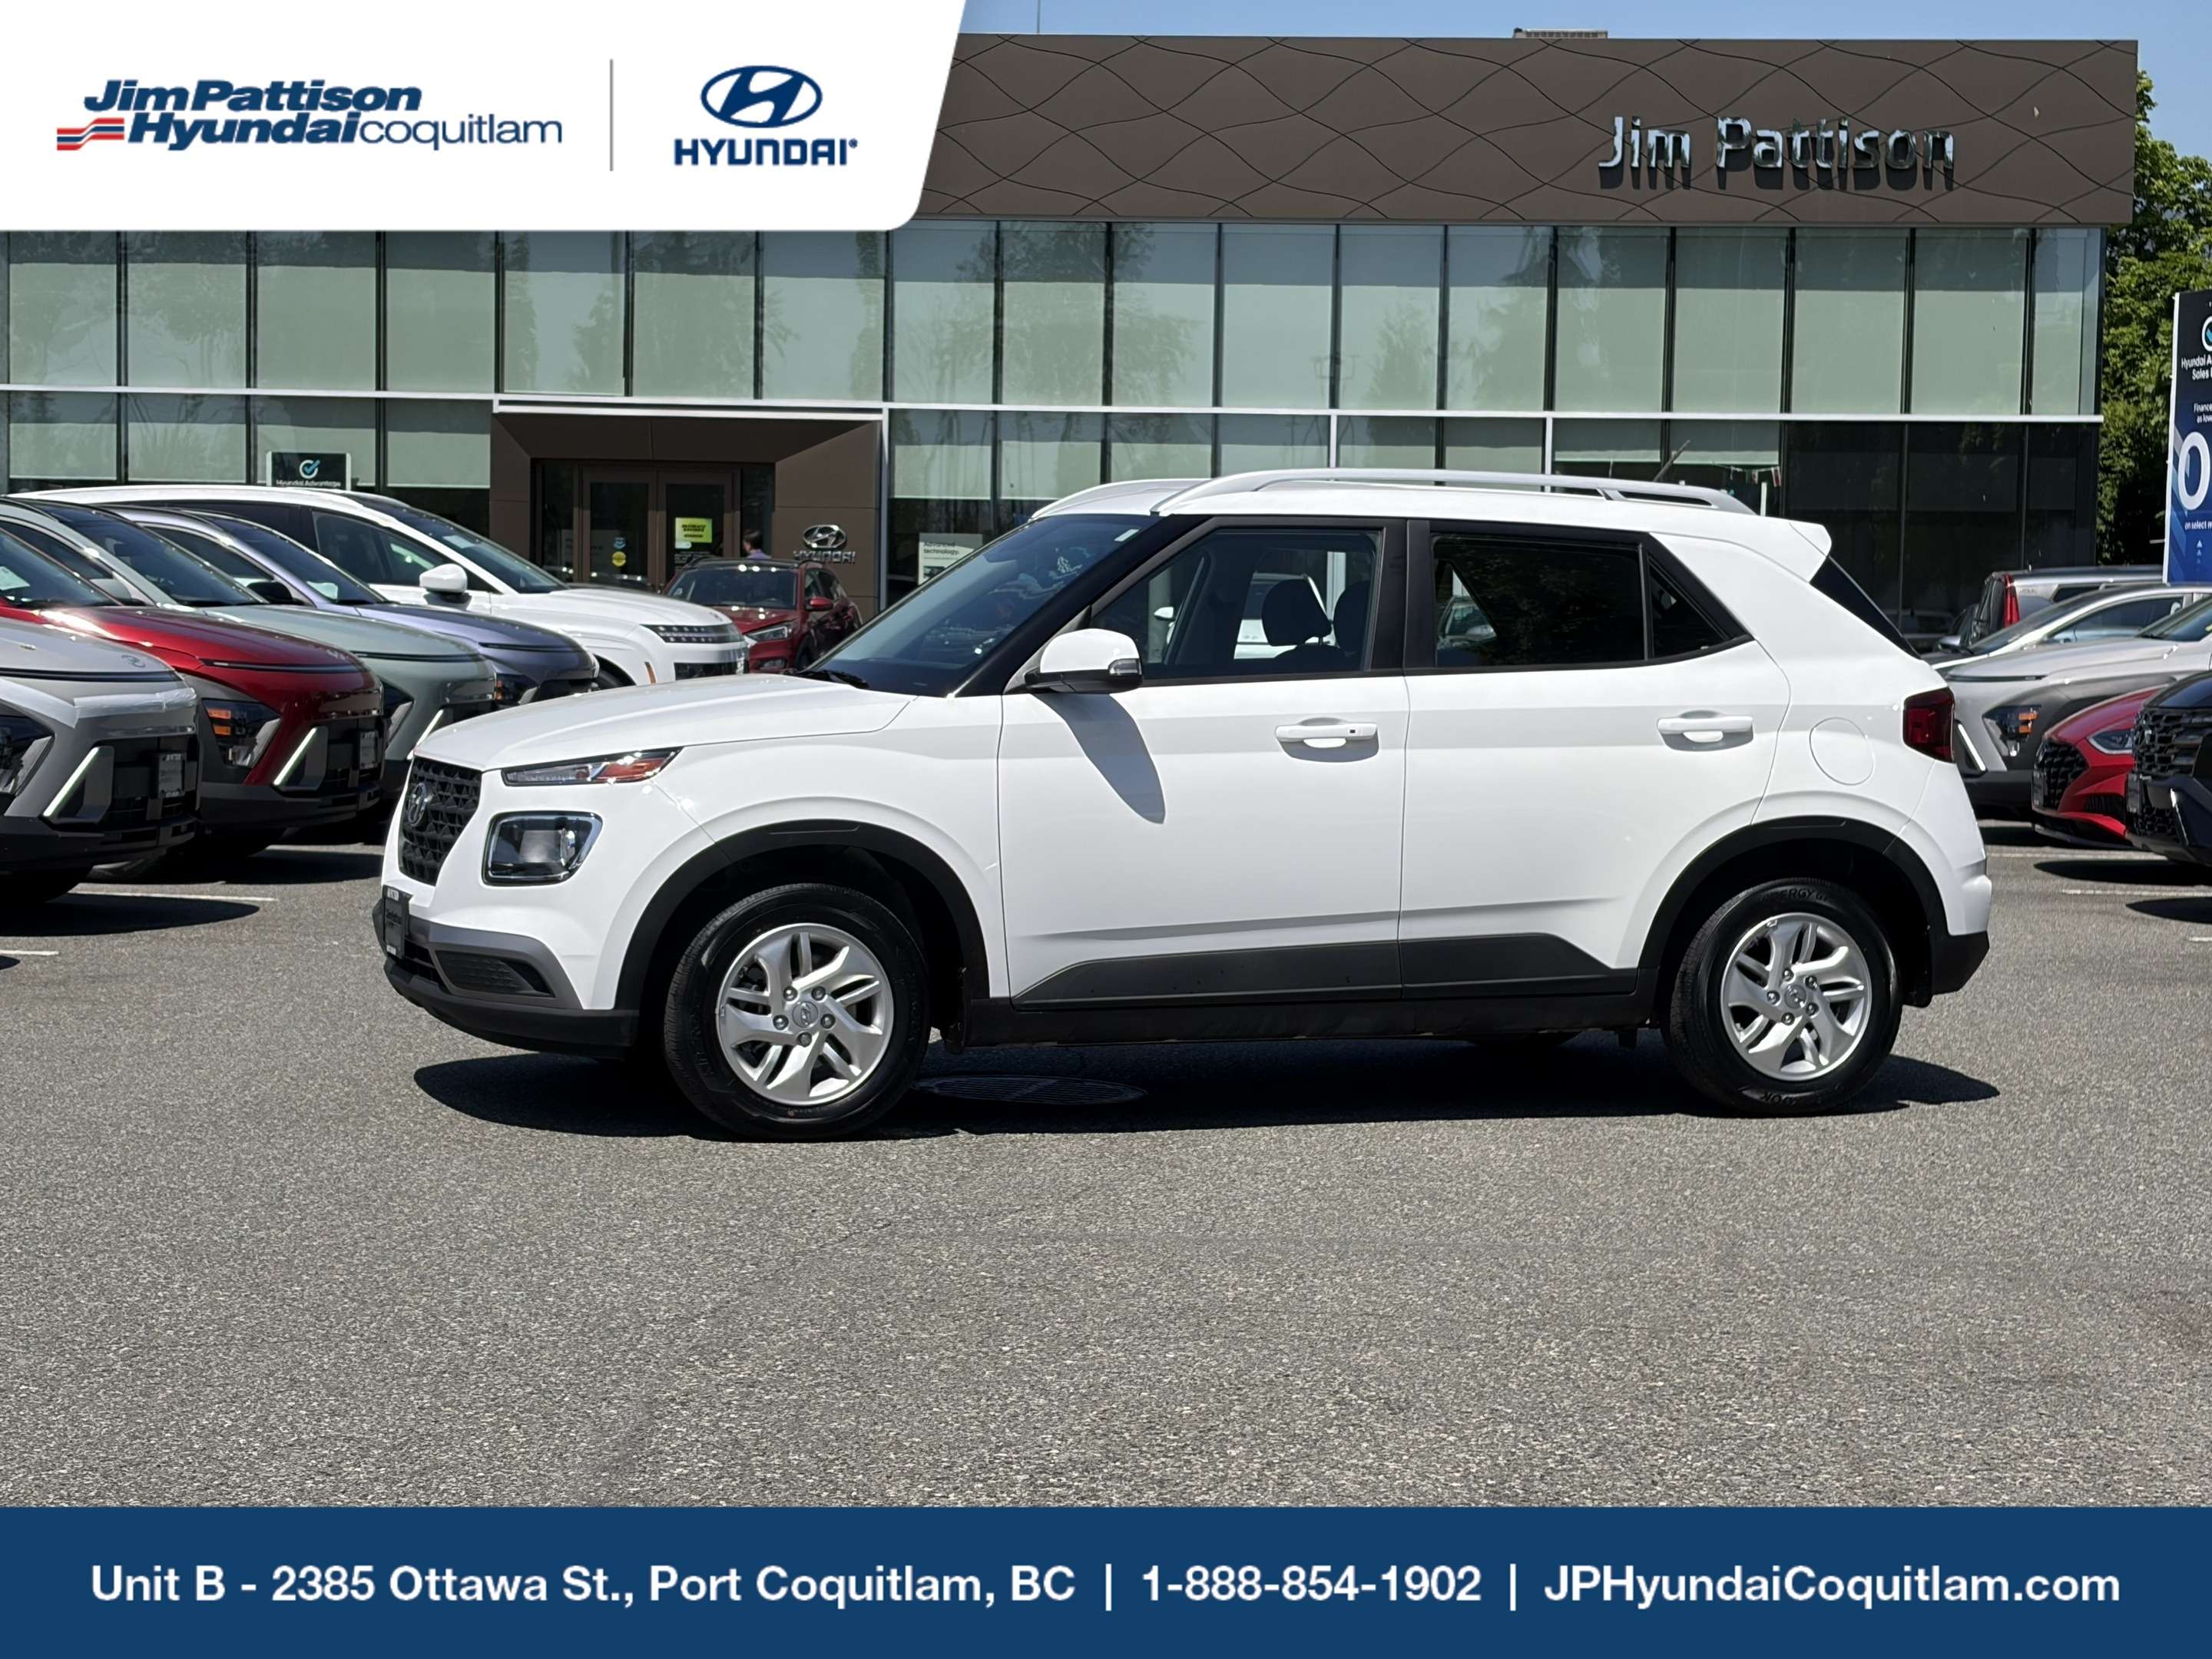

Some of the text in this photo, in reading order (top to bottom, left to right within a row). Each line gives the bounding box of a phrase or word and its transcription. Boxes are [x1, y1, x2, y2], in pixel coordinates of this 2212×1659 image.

[1598, 117, 1955, 168] Jim Pattison
[2181, 354, 2206, 370] Hyundai
[2192, 368, 2209, 380] Sales
